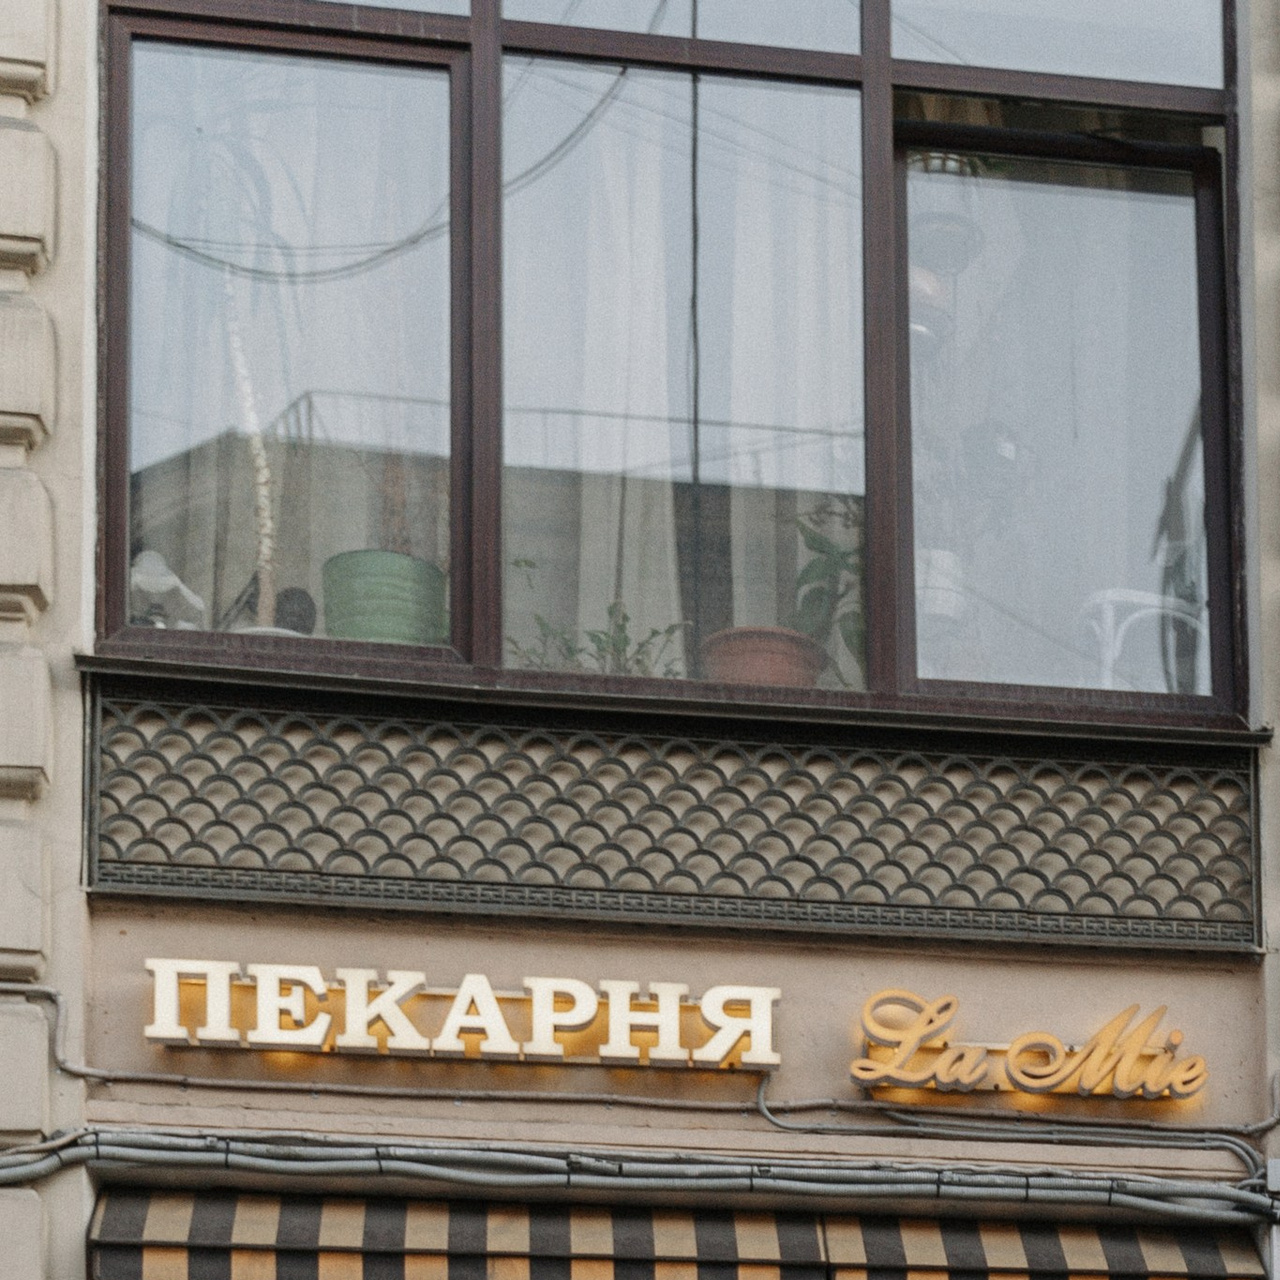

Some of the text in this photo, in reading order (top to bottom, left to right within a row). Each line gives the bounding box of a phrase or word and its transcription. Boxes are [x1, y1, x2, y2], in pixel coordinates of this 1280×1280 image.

[143, 957, 782, 1070] ПЕКАРНЯ
[851, 988, 1209, 1099] La Mie
